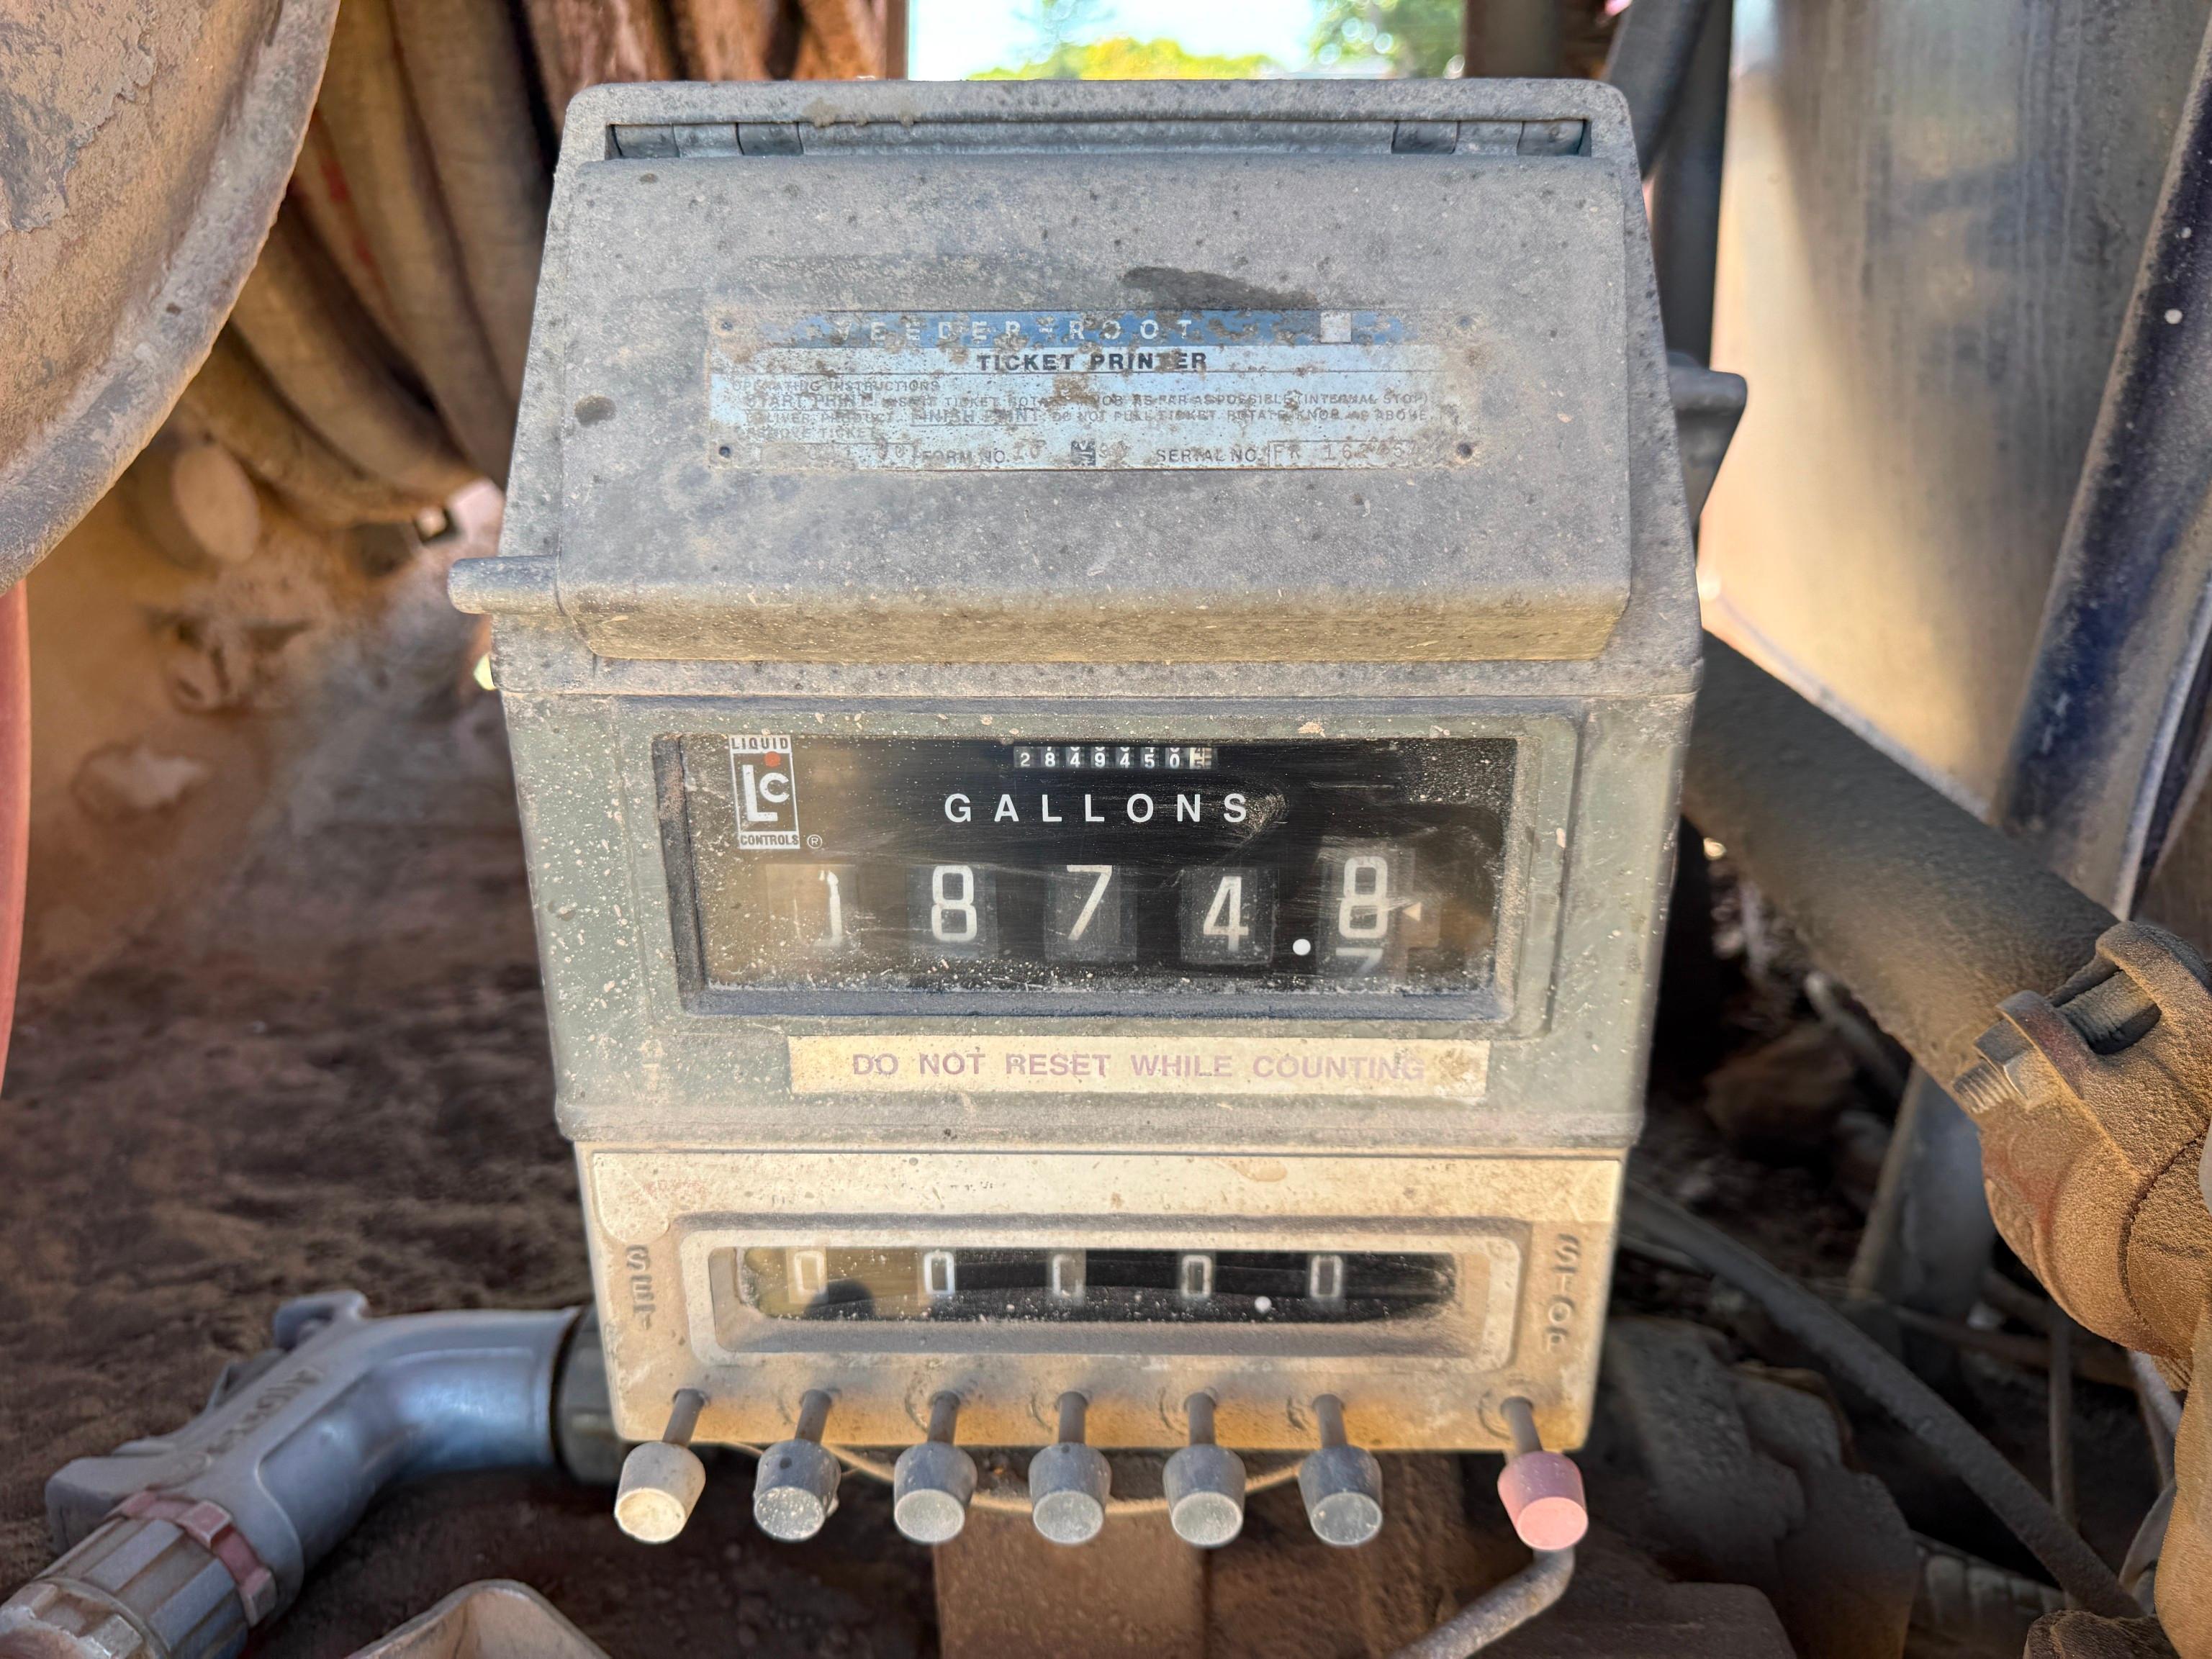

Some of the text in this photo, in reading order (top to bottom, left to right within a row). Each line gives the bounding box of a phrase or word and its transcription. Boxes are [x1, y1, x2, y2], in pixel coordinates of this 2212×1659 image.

[976, 354, 1075, 371] TICKET
[827, 380, 941, 392] INSTRUCTIONS
[746, 411, 811, 423] DLIVER
[731, 737, 788, 749] LIQUID
[944, 793, 1247, 823] GALLONS
[740, 834, 800, 846] CONTROLS
[852, 1053, 1425, 1080] DO NOT RESET WHILE COUNTING
[1545, 1233, 1581, 1355] STOP
